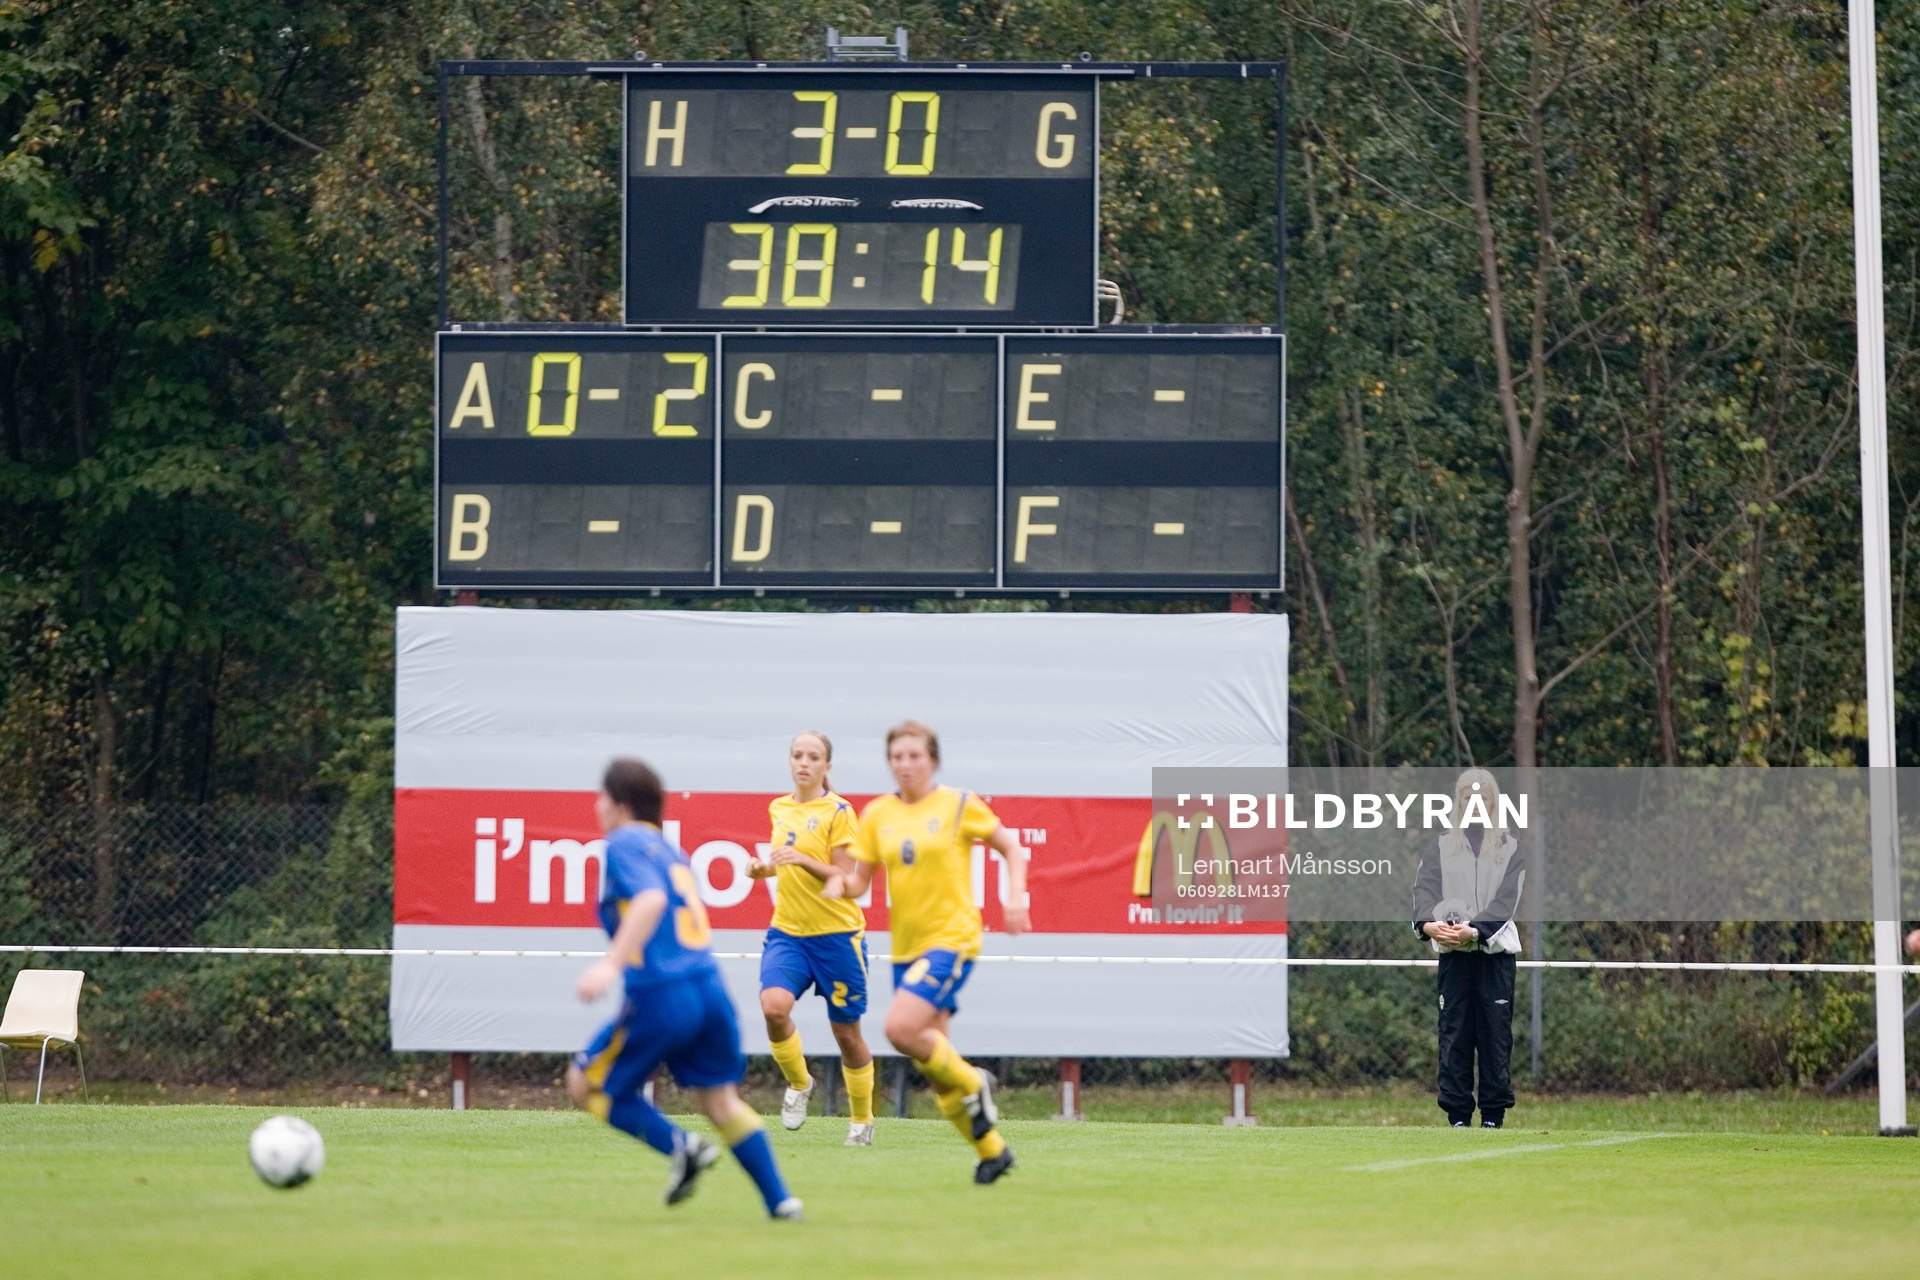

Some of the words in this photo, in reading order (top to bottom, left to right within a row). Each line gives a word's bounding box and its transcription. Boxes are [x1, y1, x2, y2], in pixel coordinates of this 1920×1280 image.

[644, 100, 688, 167] H
[1035, 102, 1078, 169] G
[449, 362, 495, 429] A
[734, 362, 776, 430] C
[1016, 364, 1062, 430] E
[448, 494, 492, 561] B
[731, 495, 774, 562] D
[1014, 496, 1060, 563] F
[474, 817, 609, 905] i'm
[1128, 903, 1161, 925] i'm
[830, 980, 849, 1008] 2
